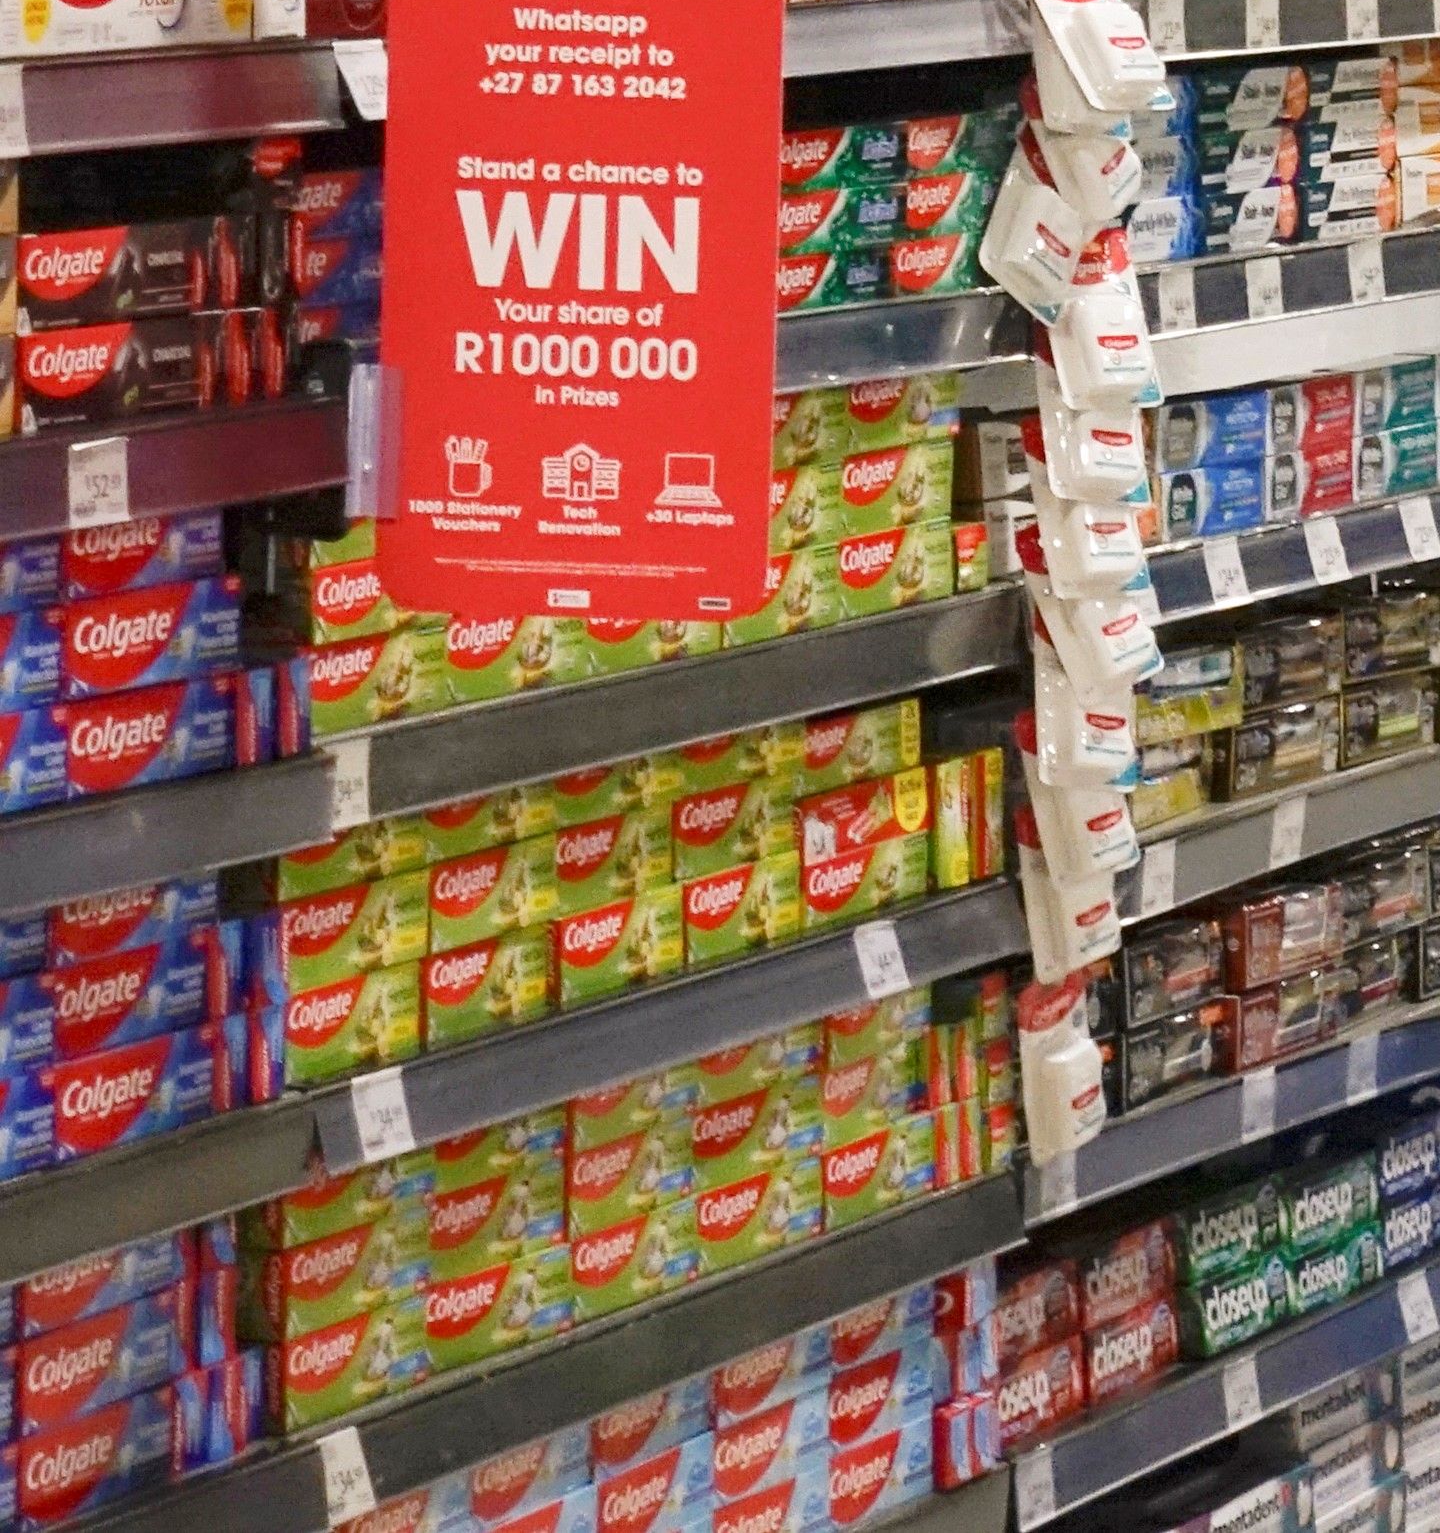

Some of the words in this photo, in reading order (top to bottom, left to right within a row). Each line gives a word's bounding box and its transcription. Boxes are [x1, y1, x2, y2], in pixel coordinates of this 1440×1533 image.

[514, 8, 648, 38] Whatsapp
[485, 43, 542, 67] your
[548, 45, 641, 69] receipt
[648, 46, 674, 67] to
[479, 73, 524, 94] +27
[533, 74, 562, 95] 87
[572, 74, 615, 97] 163
[623, 76, 686, 99] 2042
[457, 156, 535, 181] Stand
[542, 162, 560, 182] a
[569, 161, 669, 186] chance
[676, 163, 703, 186] to
[455, 190, 700, 294] WIN
[24, 247, 104, 285] Colgate
[496, 298, 552, 324] Your
[558, 302, 629, 326] share
[637, 304, 663, 326] of
[28, 344, 109, 383] Colgate
[610, 338, 697, 381] 000
[560, 386, 619, 408] Prizes
[841, 457, 898, 495] Colgate
[408, 499, 443, 516] 1000
[448, 502, 521, 519] Stationery
[433, 516, 501, 533] Vouchers
[562, 504, 598, 519] Tech
[646, 511, 671, 524] +30
[676, 511, 734, 526] Laptops
[538, 520, 621, 538] Renovation
[840, 540, 895, 576] Colgate
[73, 610, 173, 656] Colgate
[448, 618, 514, 655] Colgate
[70, 712, 167, 760] Colgate
[678, 792, 739, 832] Colgate
[434, 865, 499, 906] Colgate
[689, 877, 745, 915] Colgate
[288, 994, 352, 1031] Colgate
[434, 1194, 492, 1233] Colgate
[701, 1188, 759, 1226] Colgate
[1295, 1182, 1353, 1229] closeup
[1386, 1200, 1432, 1247] closeup
[1191, 1202, 1256, 1250] closeup
[1087, 1251, 1148, 1298] closeup
[1299, 1255, 1346, 1296] closeup
[1207, 1277, 1267, 1329] closeup
[27, 1337, 113, 1393] Colgate
[288, 1330, 357, 1375] Colgate
[1093, 1325, 1154, 1376] closeup
[830, 1378, 890, 1420] Colgate
[999, 1375, 1050, 1419] oseup
[603, 1473, 669, 1526] Colgate
